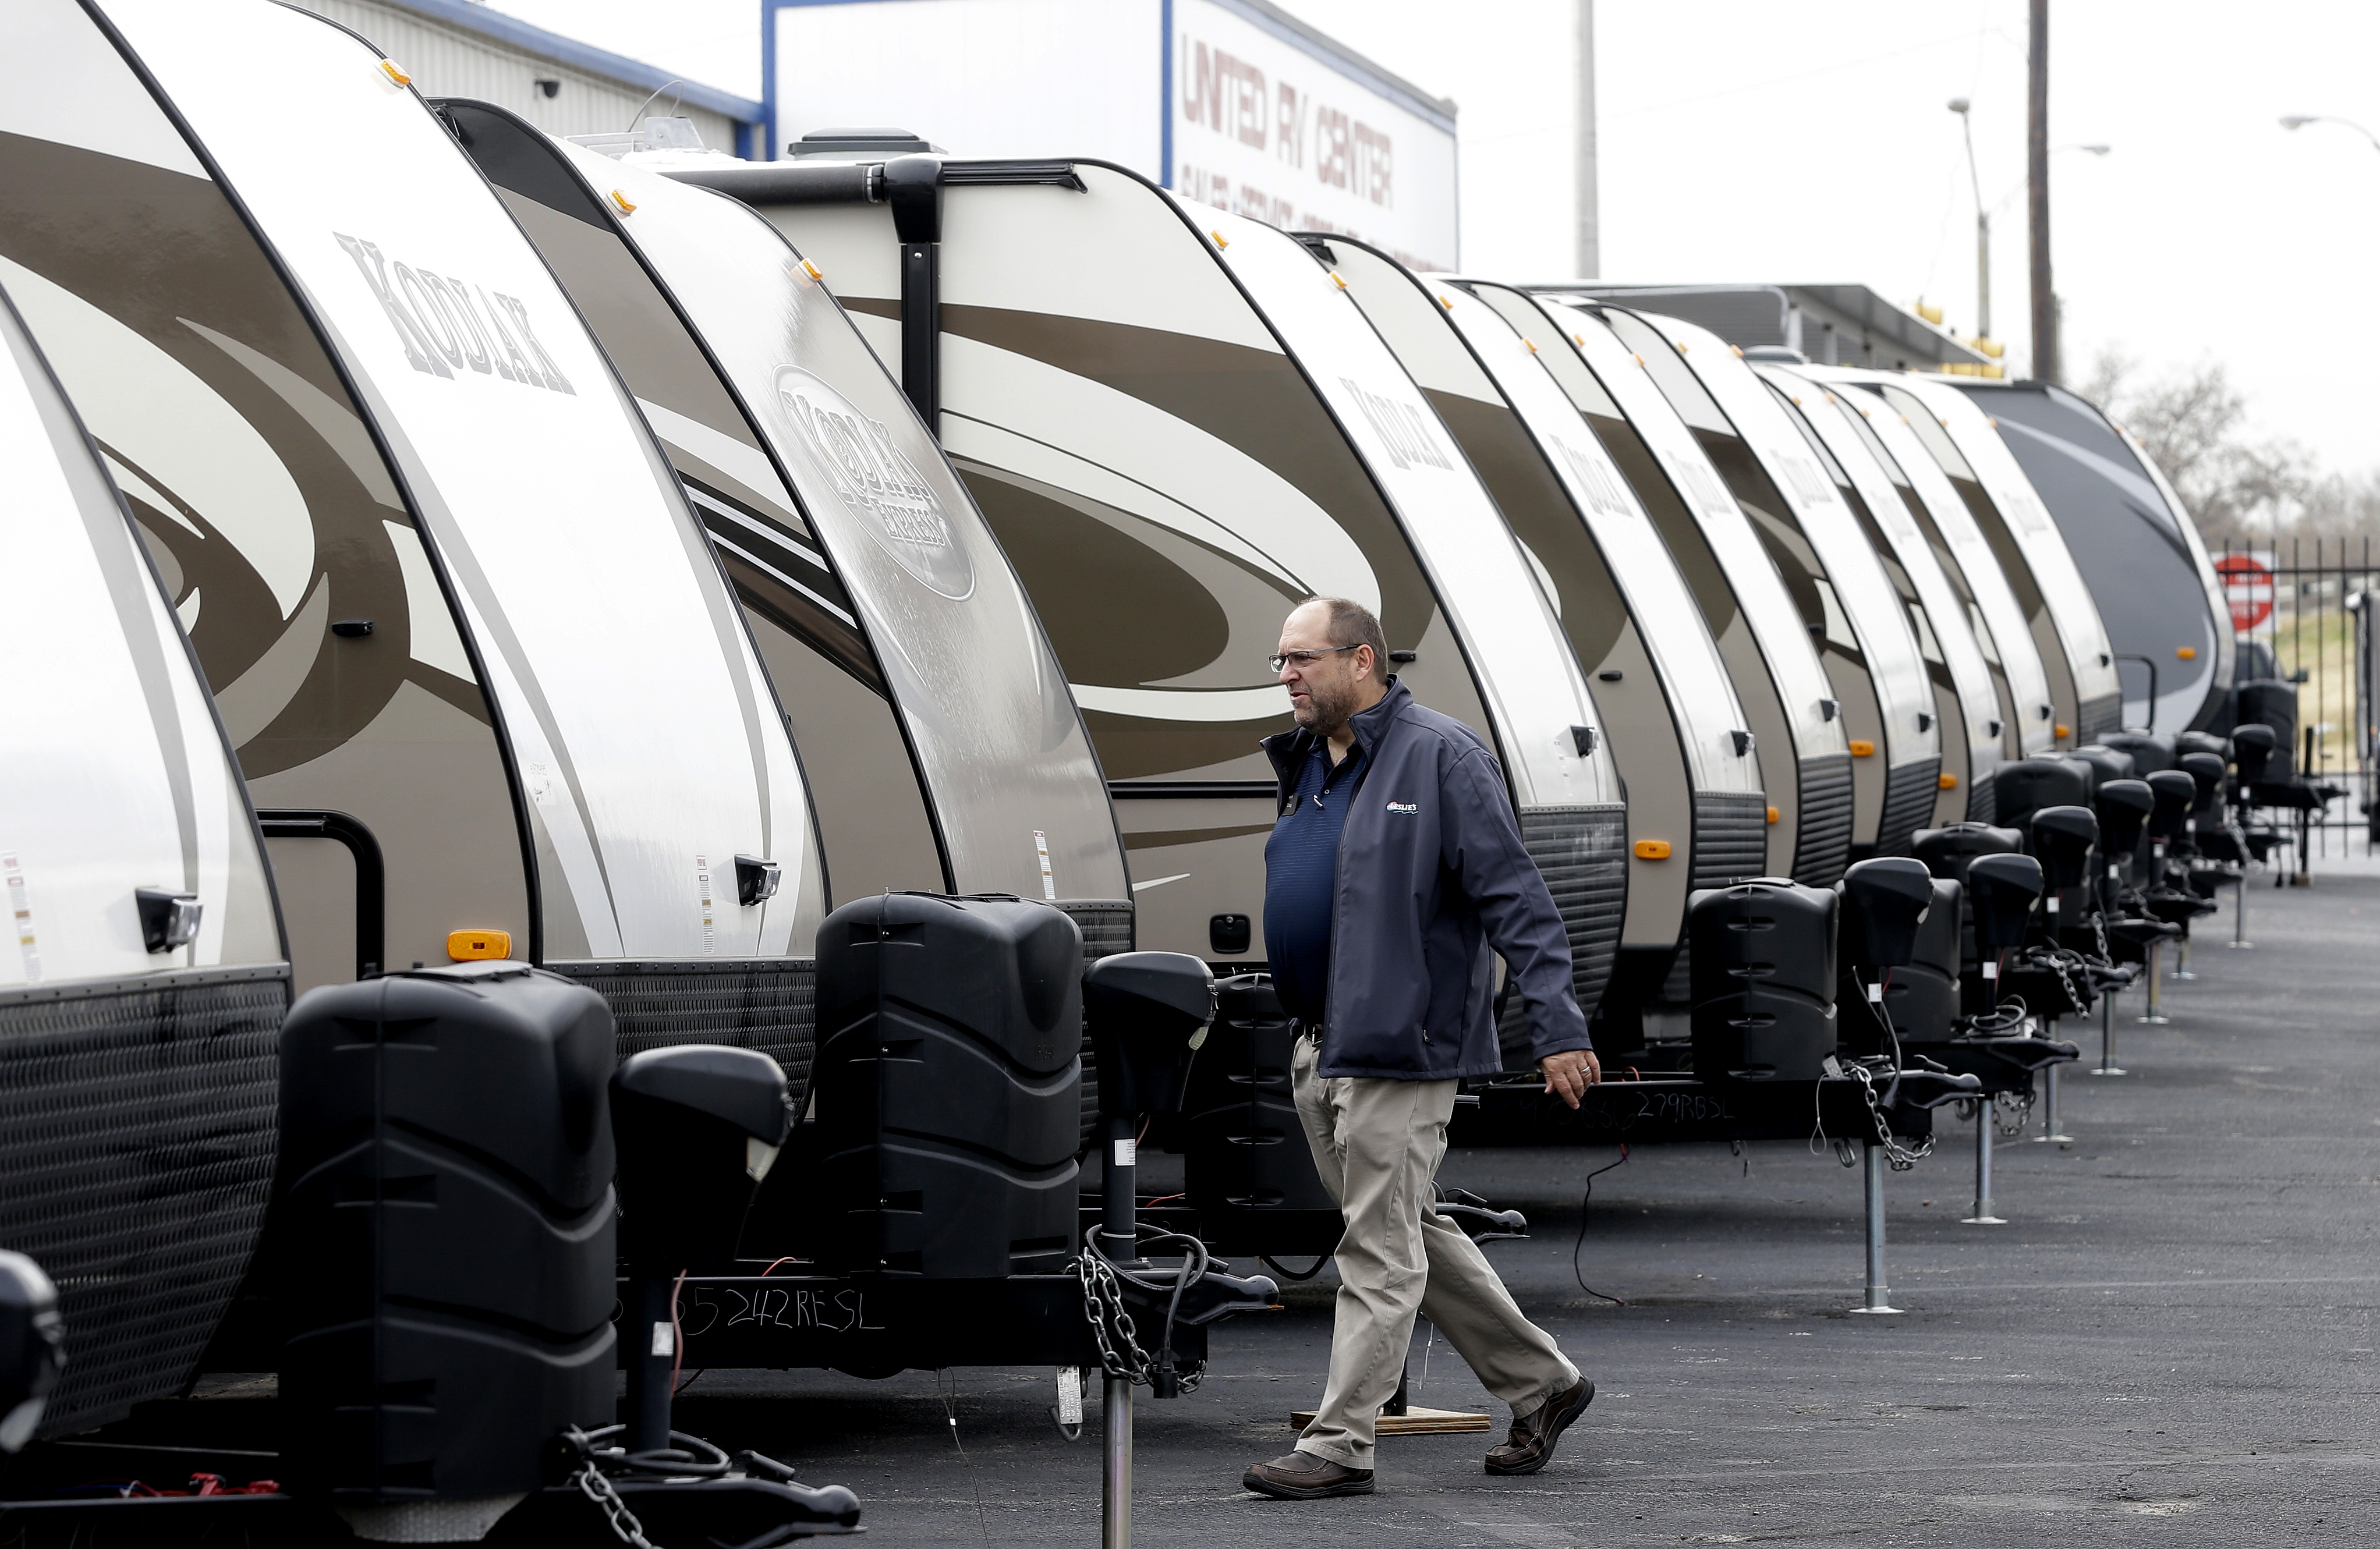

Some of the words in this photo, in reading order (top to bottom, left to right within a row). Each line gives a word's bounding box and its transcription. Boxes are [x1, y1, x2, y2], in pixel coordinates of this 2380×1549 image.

[1181, 33, 1267, 150] UNITED
[1318, 105, 1394, 211] CENTER
[332, 231, 578, 397] KODIAK
[781, 390, 930, 506] KODIAK
[870, 497, 945, 546] EXPRESS
[1389, 803, 1417, 811] LESLIE'S
[725, 1289, 886, 1332] 242RESL
